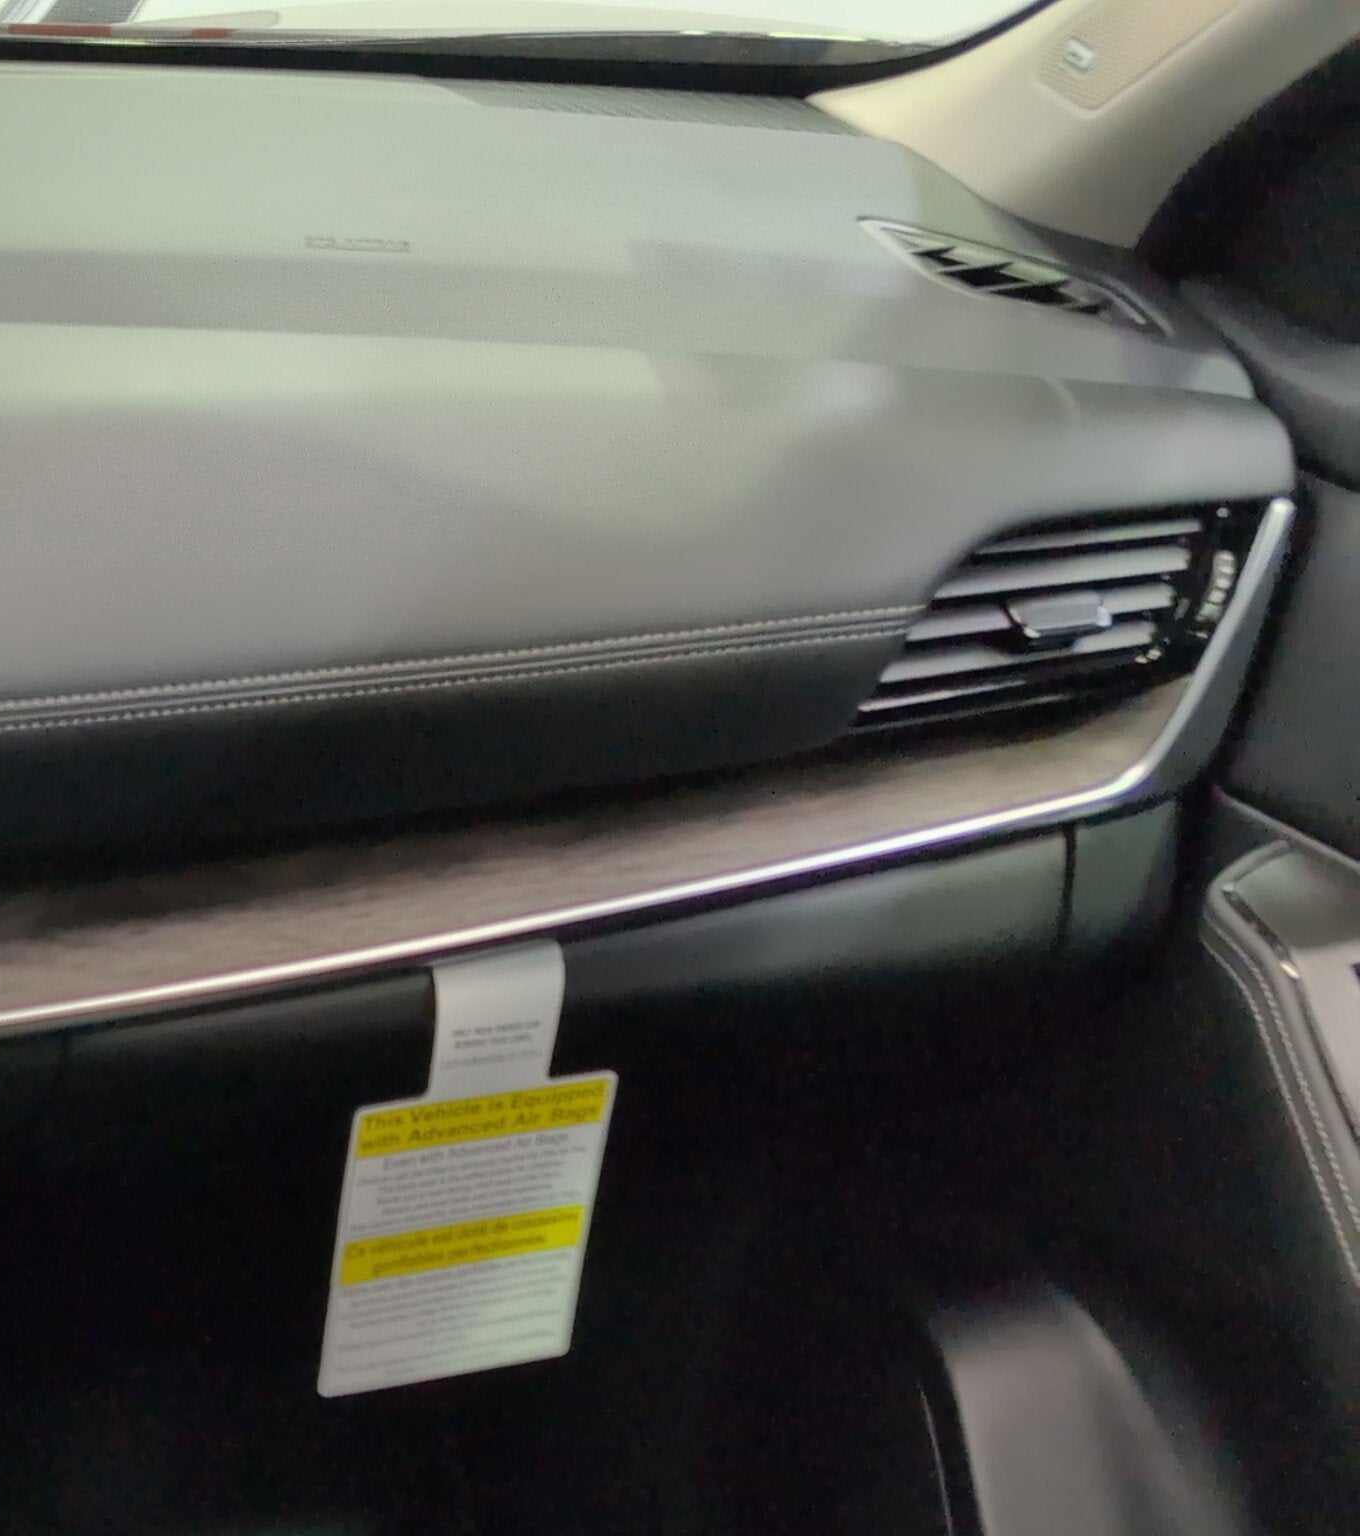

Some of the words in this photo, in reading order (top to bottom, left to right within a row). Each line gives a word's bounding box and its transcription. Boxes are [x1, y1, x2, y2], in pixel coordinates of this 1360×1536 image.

[360, 1131, 401, 1151] with
[407, 1114, 506, 1144] Advanced
[513, 1110, 541, 1127] Air
[550, 1102, 600, 1125] Bags
[364, 1112, 403, 1130] This
[408, 1100, 481, 1124] Vehicle
[509, 1082, 605, 1111] Equipped
